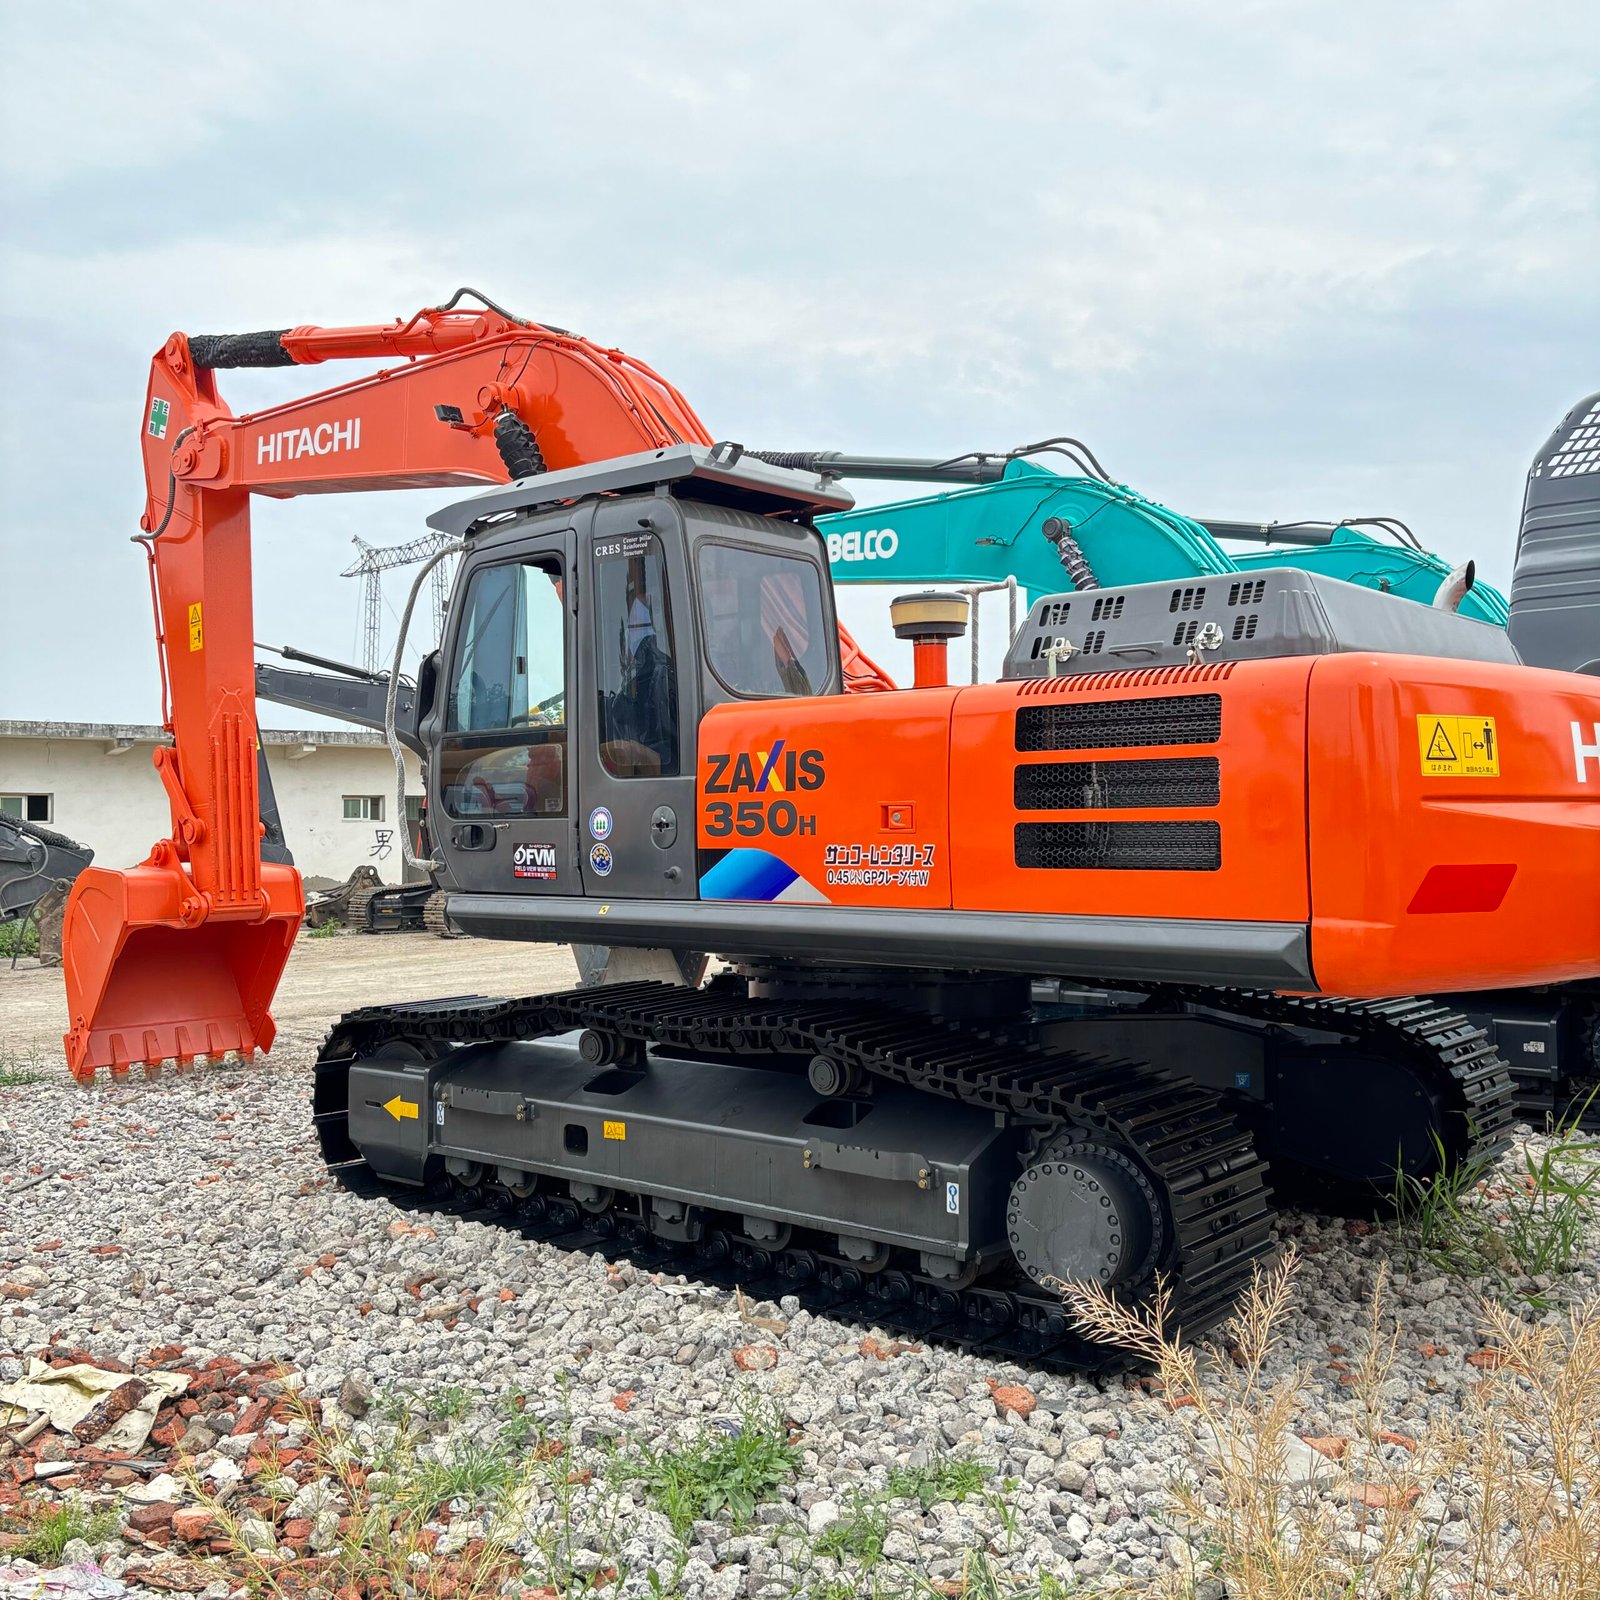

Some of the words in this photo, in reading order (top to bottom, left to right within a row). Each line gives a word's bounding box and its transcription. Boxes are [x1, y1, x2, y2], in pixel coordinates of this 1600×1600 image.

[257, 418, 361, 464] HITACHI
[595, 543, 621, 557] CRES
[639, 534, 652, 543] pillar
[704, 739, 826, 794] ZAXIS
[369, 829, 394, 861] 男
[526, 848, 556, 866] FVM
